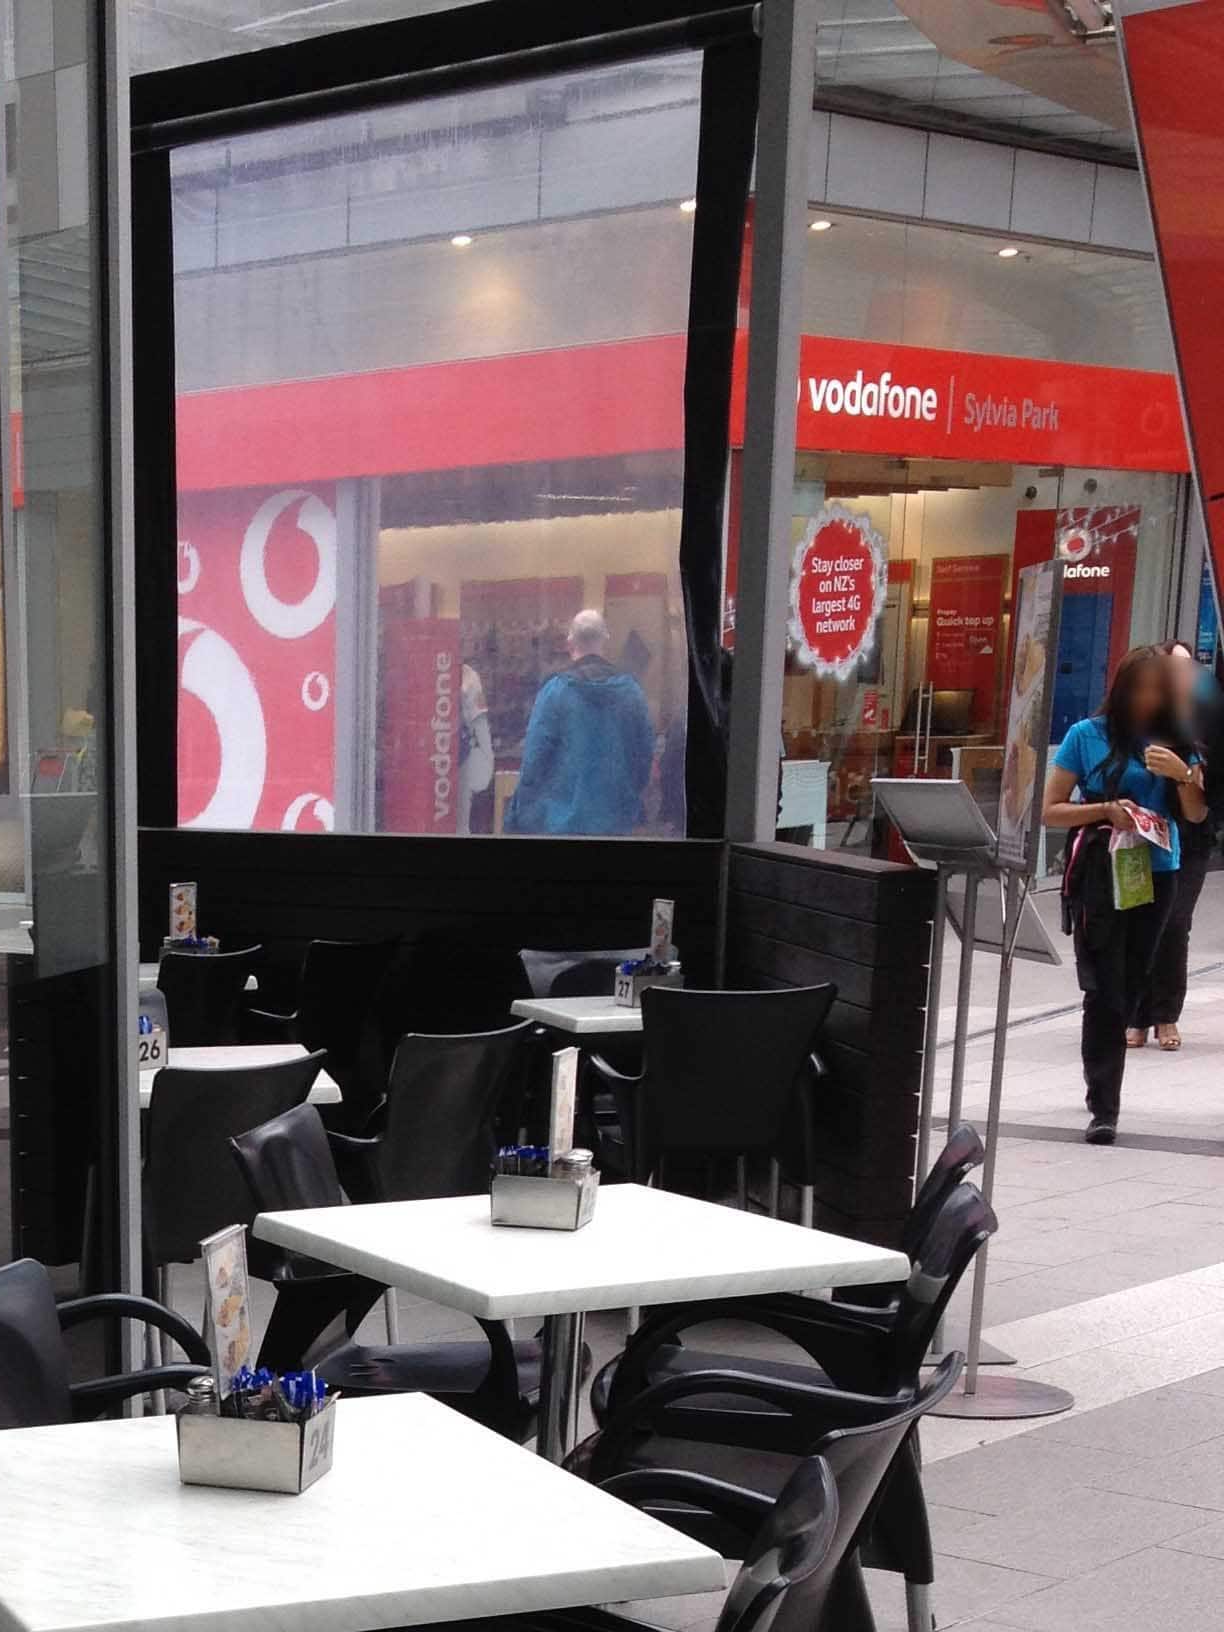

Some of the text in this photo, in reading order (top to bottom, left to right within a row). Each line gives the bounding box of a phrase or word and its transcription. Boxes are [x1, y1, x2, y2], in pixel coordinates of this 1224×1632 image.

[808, 370, 1059, 432] vodafone Sylvia Park
[812, 556, 864, 576] Stay closer
[1063, 564, 1111, 578] afone
[819, 576, 855, 593] on NZ's
[812, 595, 861, 616] largest 4G
[816, 615, 856, 633] network
[430, 651, 452, 822] vodafone
[618, 980, 631, 999] 27
[139, 1040, 161, 1062] 26
[309, 1421, 329, 1471] 24
